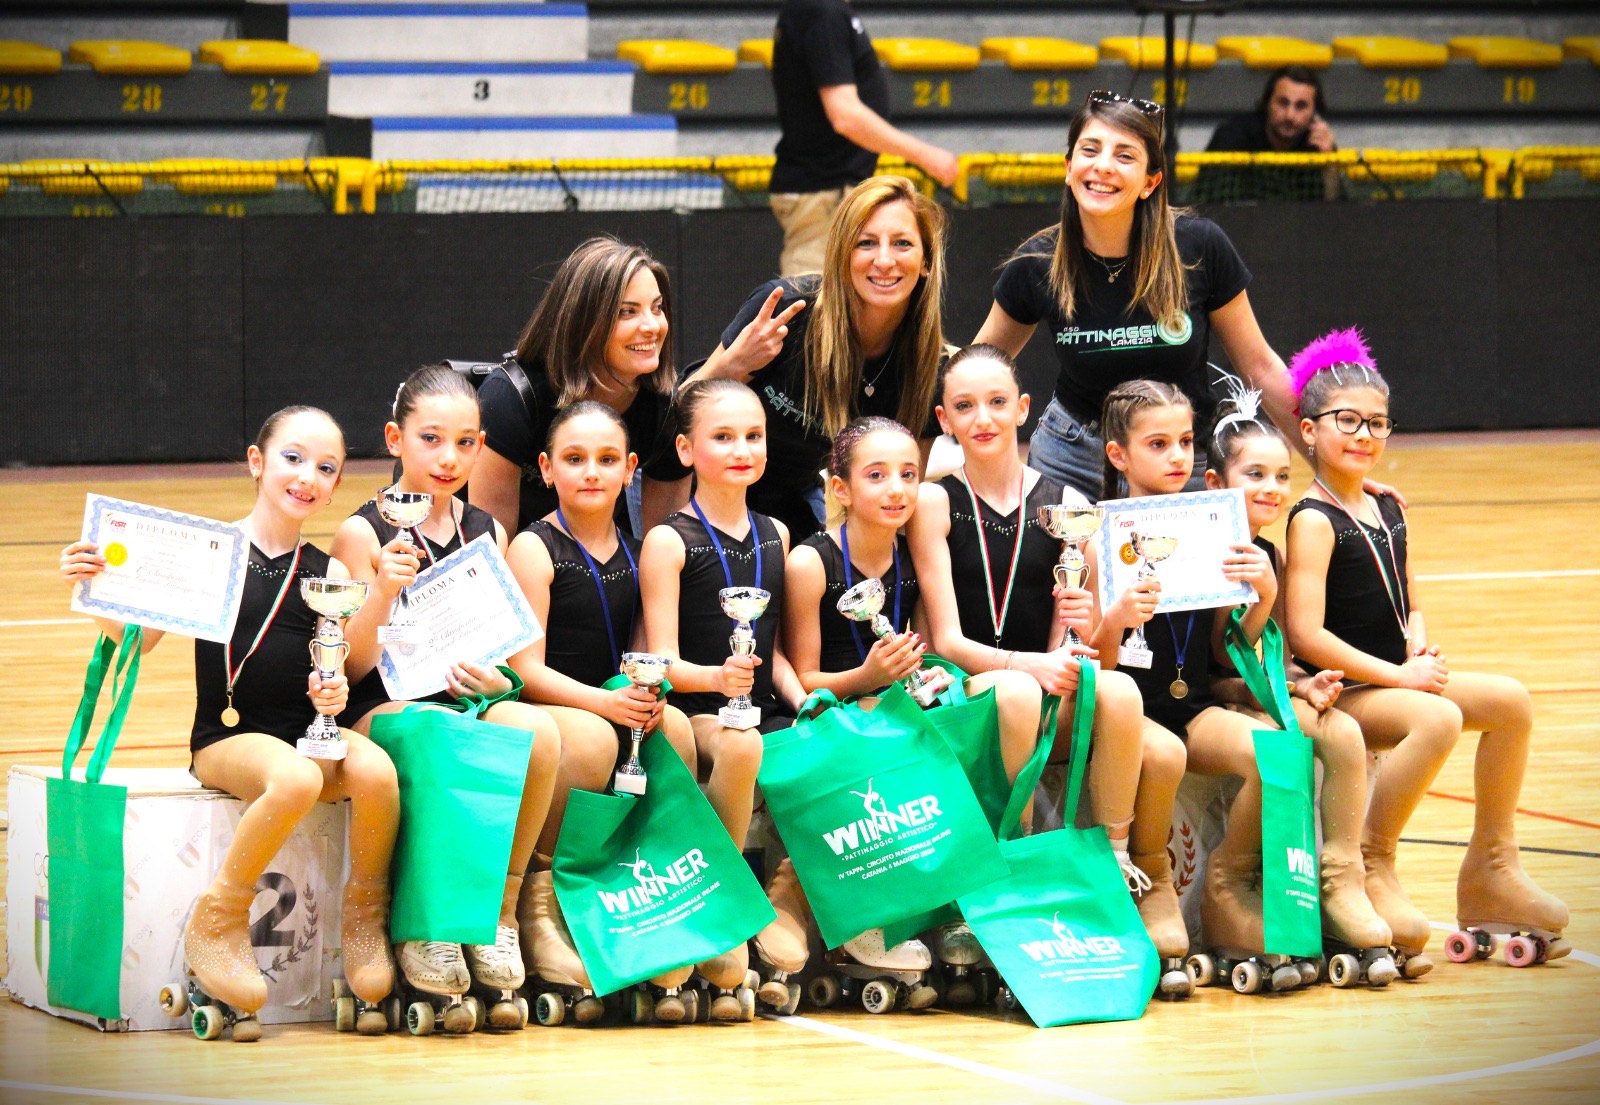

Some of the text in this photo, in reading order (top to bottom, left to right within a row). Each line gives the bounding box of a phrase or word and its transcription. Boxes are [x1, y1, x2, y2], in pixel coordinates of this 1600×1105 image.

[122, 84, 162, 112] 28
[250, 84, 289, 112] 27
[474, 79, 490, 101] 3
[668, 81, 709, 110] 26
[913, 79, 951, 108] 24
[1032, 79, 1070, 107] 23
[1384, 78, 1421, 104] 20
[1504, 76, 1536, 104] 19
[1110, 337, 1154, 347] LAMEZIA
[110, 519, 127, 529] FISR
[1120, 520, 1135, 528] FISR
[1141, 511, 1197, 522] DIPLOMA
[136, 522, 197, 542] DIPLOMA
[410, 575, 456, 608] IPLOMA
[822, 795, 944, 856] WINNER
[844, 823, 935, 862] PATTINAGGIO ARTISTICO
[845, 865, 865, 877] TAPPA
[866, 852, 895, 869] CIRCUITO
[895, 839, 932, 859] NAZIONALE
[862, 866, 888, 880] CATANIA
[893, 853, 920, 868] MAGGIO
[596, 848, 710, 913] WINNER
[251, 872, 297, 947] 2
[615, 876, 703, 921] PATTINAGGIO ARTISTICO
[636, 913, 666, 928] CIRCUITO
[1018, 936, 1127, 962] WINNER
